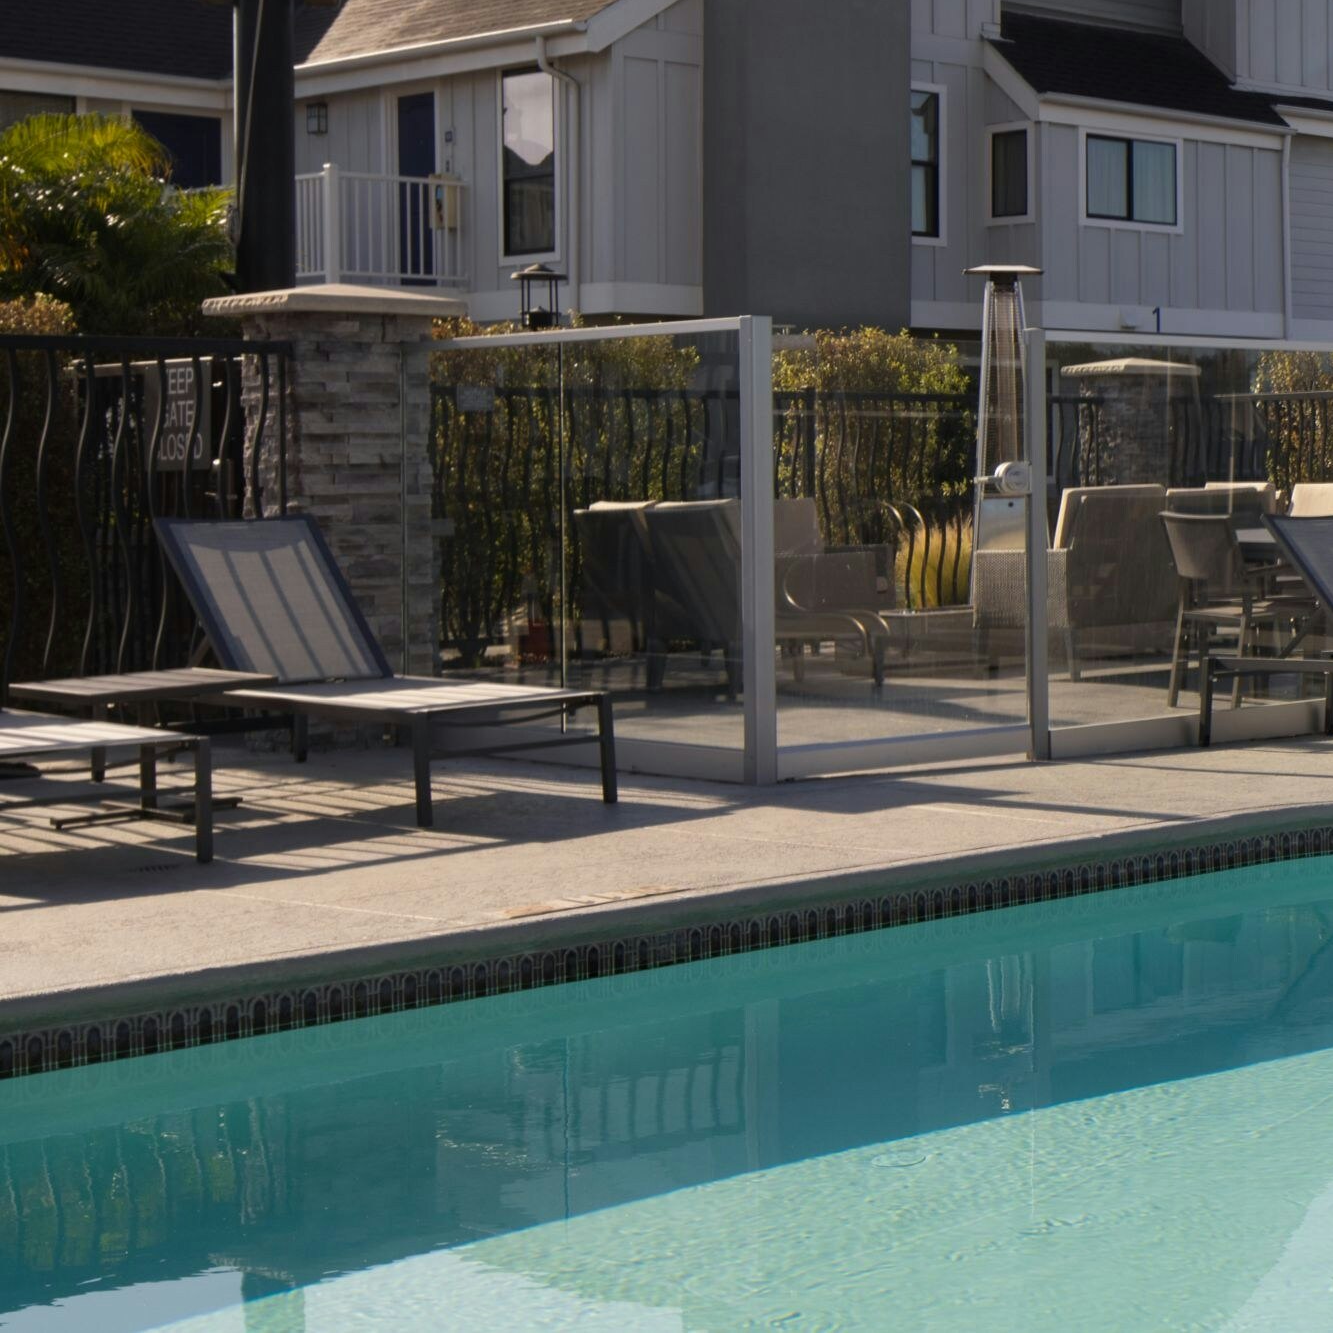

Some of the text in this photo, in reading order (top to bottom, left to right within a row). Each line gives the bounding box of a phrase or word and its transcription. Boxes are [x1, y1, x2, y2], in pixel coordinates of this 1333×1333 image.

[1152, 307, 1160, 333] 1
[165, 367, 194, 395] EEP
[158, 432, 203, 460] LOSD
